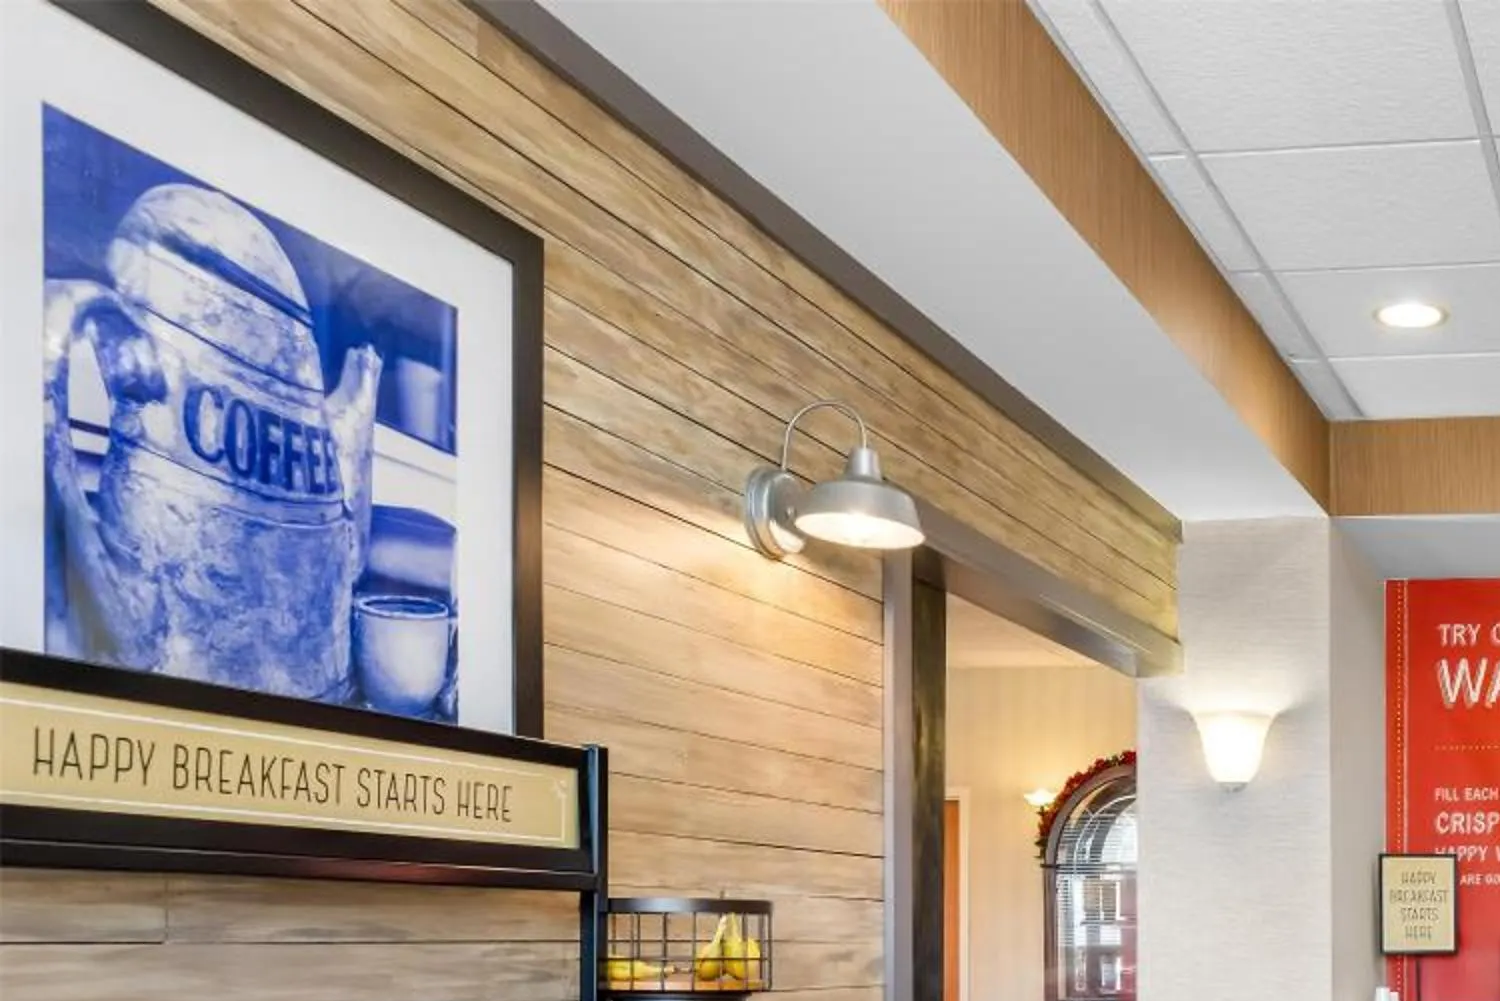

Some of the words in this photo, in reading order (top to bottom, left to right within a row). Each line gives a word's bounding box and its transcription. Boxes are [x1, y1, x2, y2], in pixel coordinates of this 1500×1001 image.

[183, 384, 339, 495] COFFEE
[1439, 623, 1481, 647] TRY
[33, 727, 156, 786] HAPPY
[173, 743, 346, 805] BREAKFAST
[357, 767, 447, 817] STARTS
[457, 780, 514, 823] HERE
[1434, 787, 1460, 801] FILL
[1464, 787, 1499, 801] EACH
[1435, 811, 1500, 834] CRISP
[1401, 870, 1438, 885] HAPPY
[1460, 873, 1481, 885] ARE
[1389, 889, 1449, 905] BREAKFAST
[1400, 907, 1440, 922] STARTS
[1404, 925, 1434, 940] HERE
